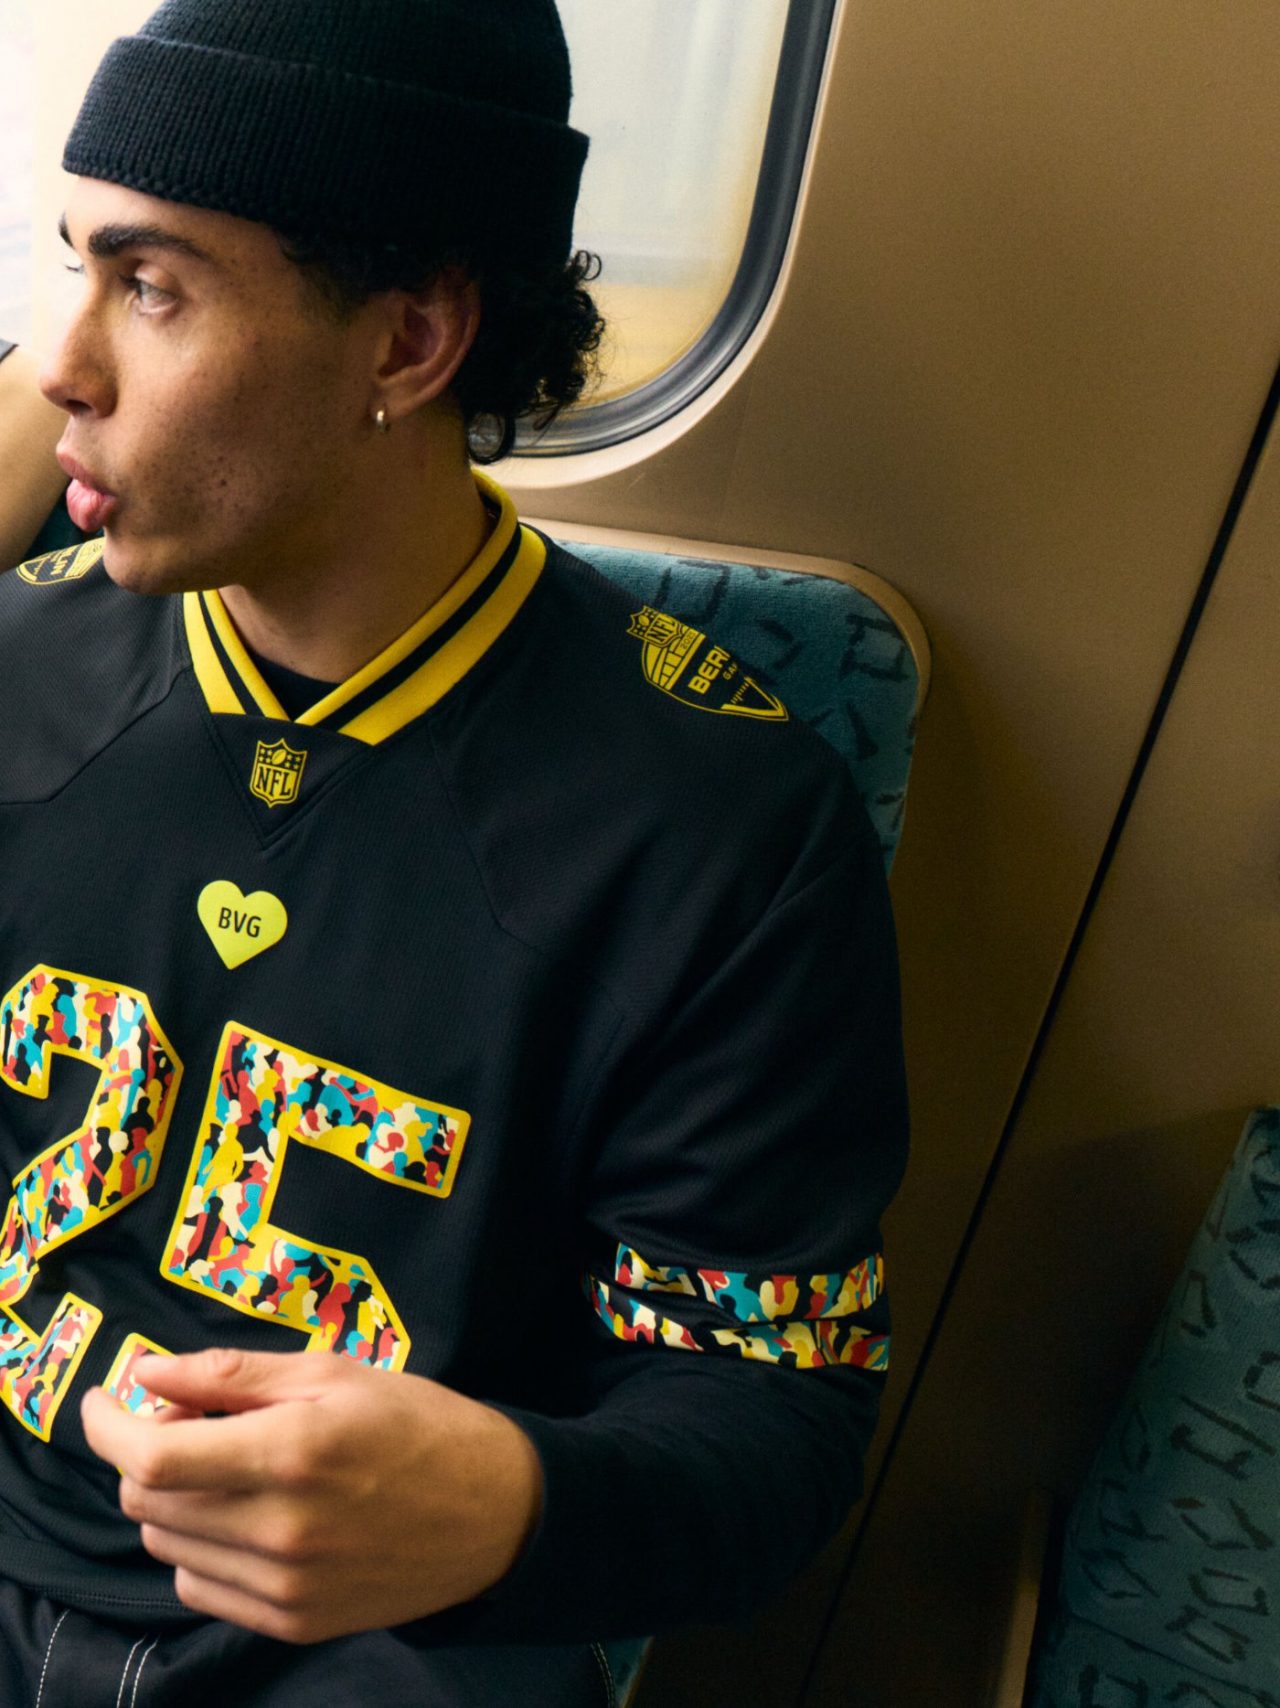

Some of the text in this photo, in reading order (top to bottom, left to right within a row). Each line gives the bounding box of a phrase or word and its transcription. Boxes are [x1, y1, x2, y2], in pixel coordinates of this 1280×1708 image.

[646, 616, 677, 643] NFL
[255, 764, 292, 797] NFL
[218, 907, 262, 938] BVG
